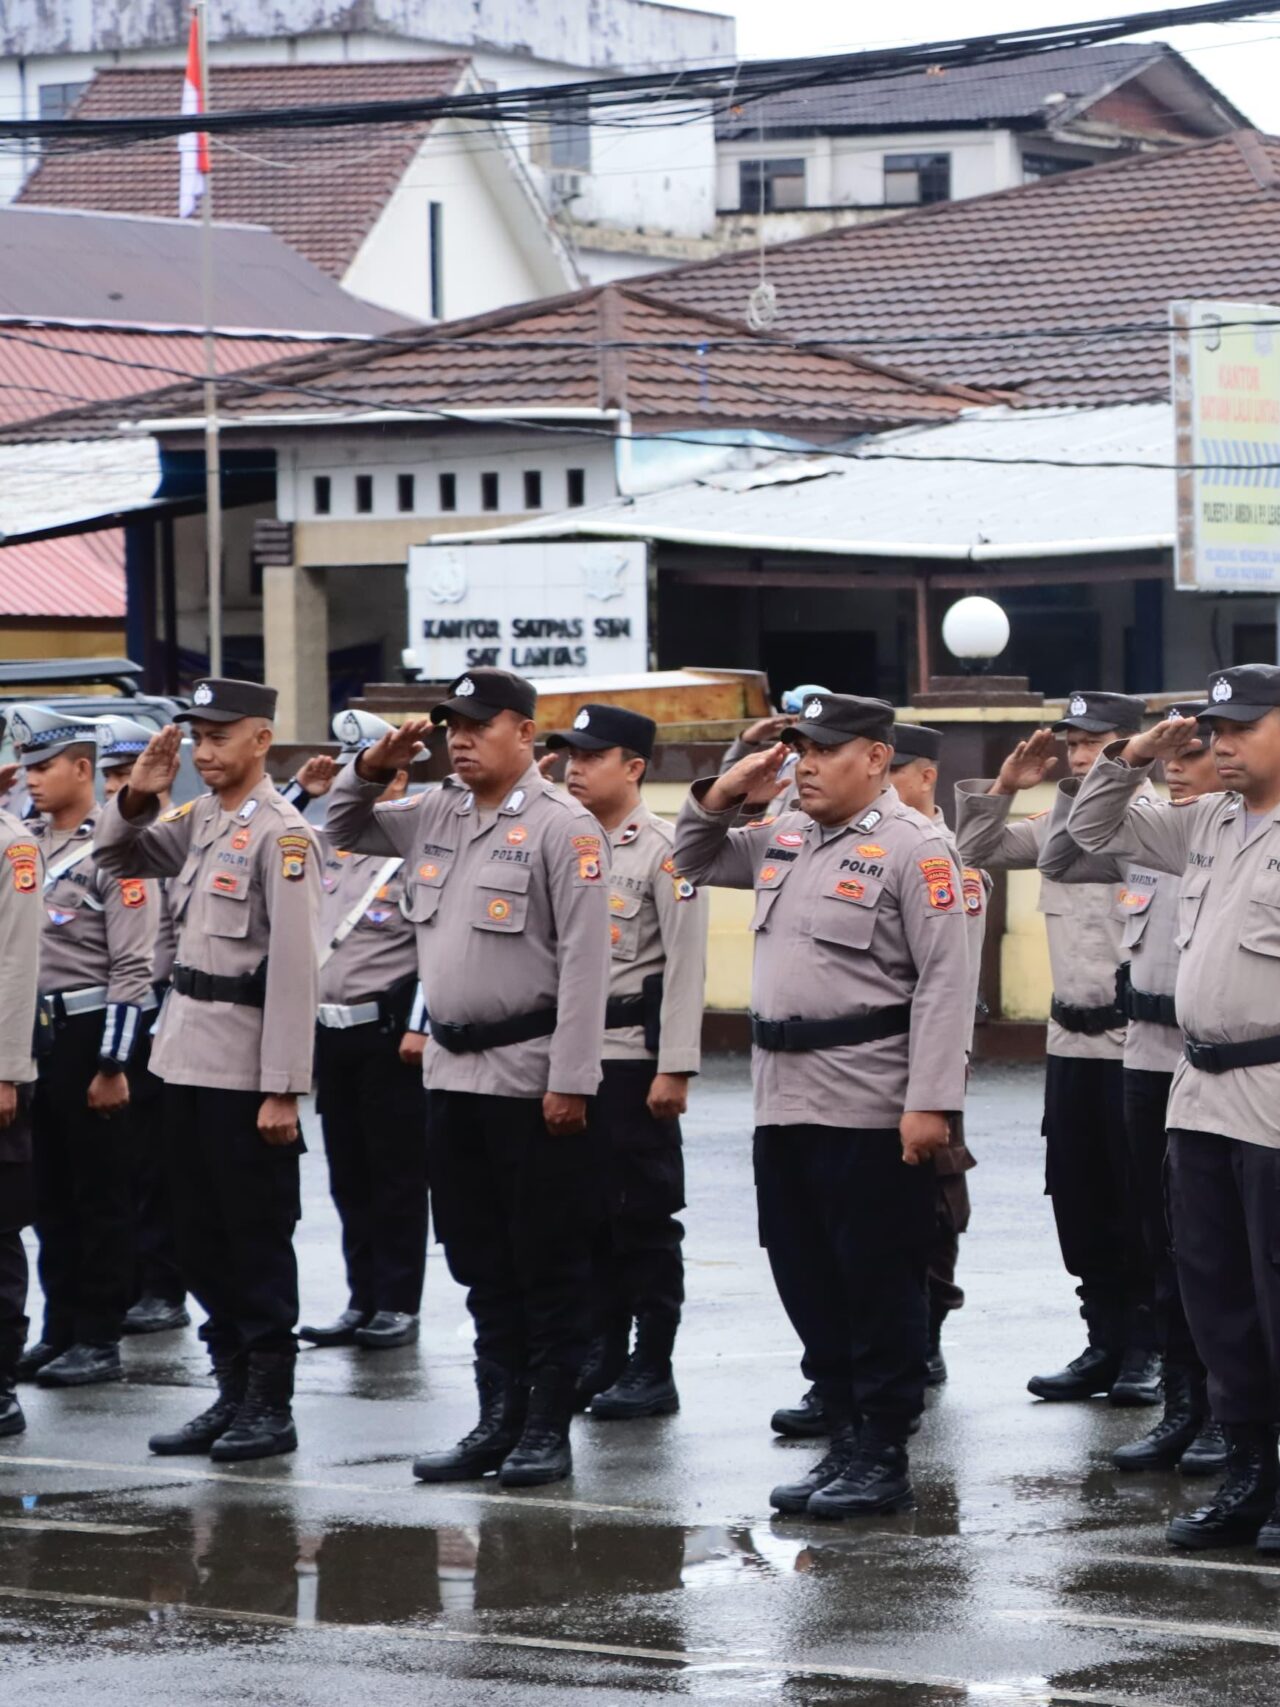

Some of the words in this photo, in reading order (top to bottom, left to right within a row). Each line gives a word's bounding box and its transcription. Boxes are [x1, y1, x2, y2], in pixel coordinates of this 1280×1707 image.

[423, 618, 501, 639] KANTOR
[511, 618, 583, 639] SATPAS
[466, 647, 502, 668] SAT
[511, 646, 587, 668] LANTAS
[218, 851, 249, 868] POLRI
[490, 849, 531, 864] POLRI
[839, 859, 885, 879] POLRI
[610, 874, 642, 892] OLRI
